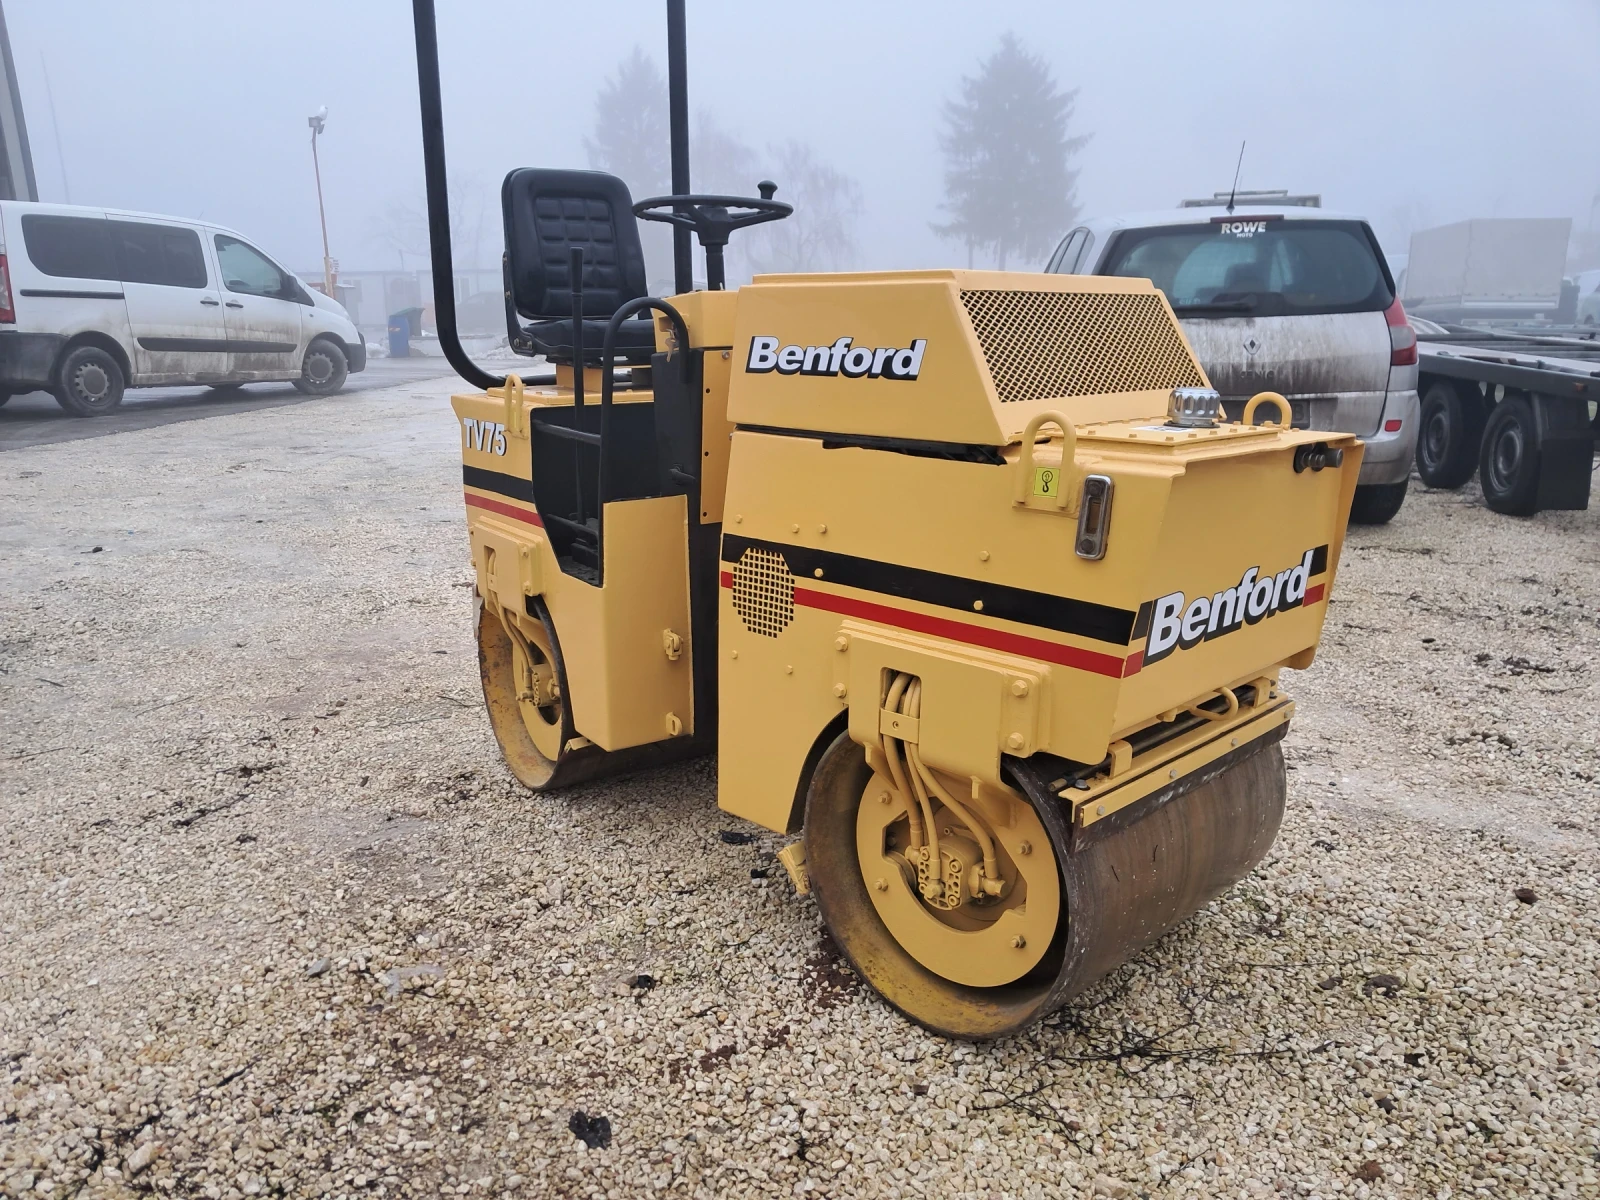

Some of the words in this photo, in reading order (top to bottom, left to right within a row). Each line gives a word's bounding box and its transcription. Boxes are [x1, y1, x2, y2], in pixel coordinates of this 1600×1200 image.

[1221, 222, 1267, 234] ROWE
[747, 336, 927, 380] Benford
[463, 417, 507, 456] TV75
[1144, 549, 1315, 666] Benford
